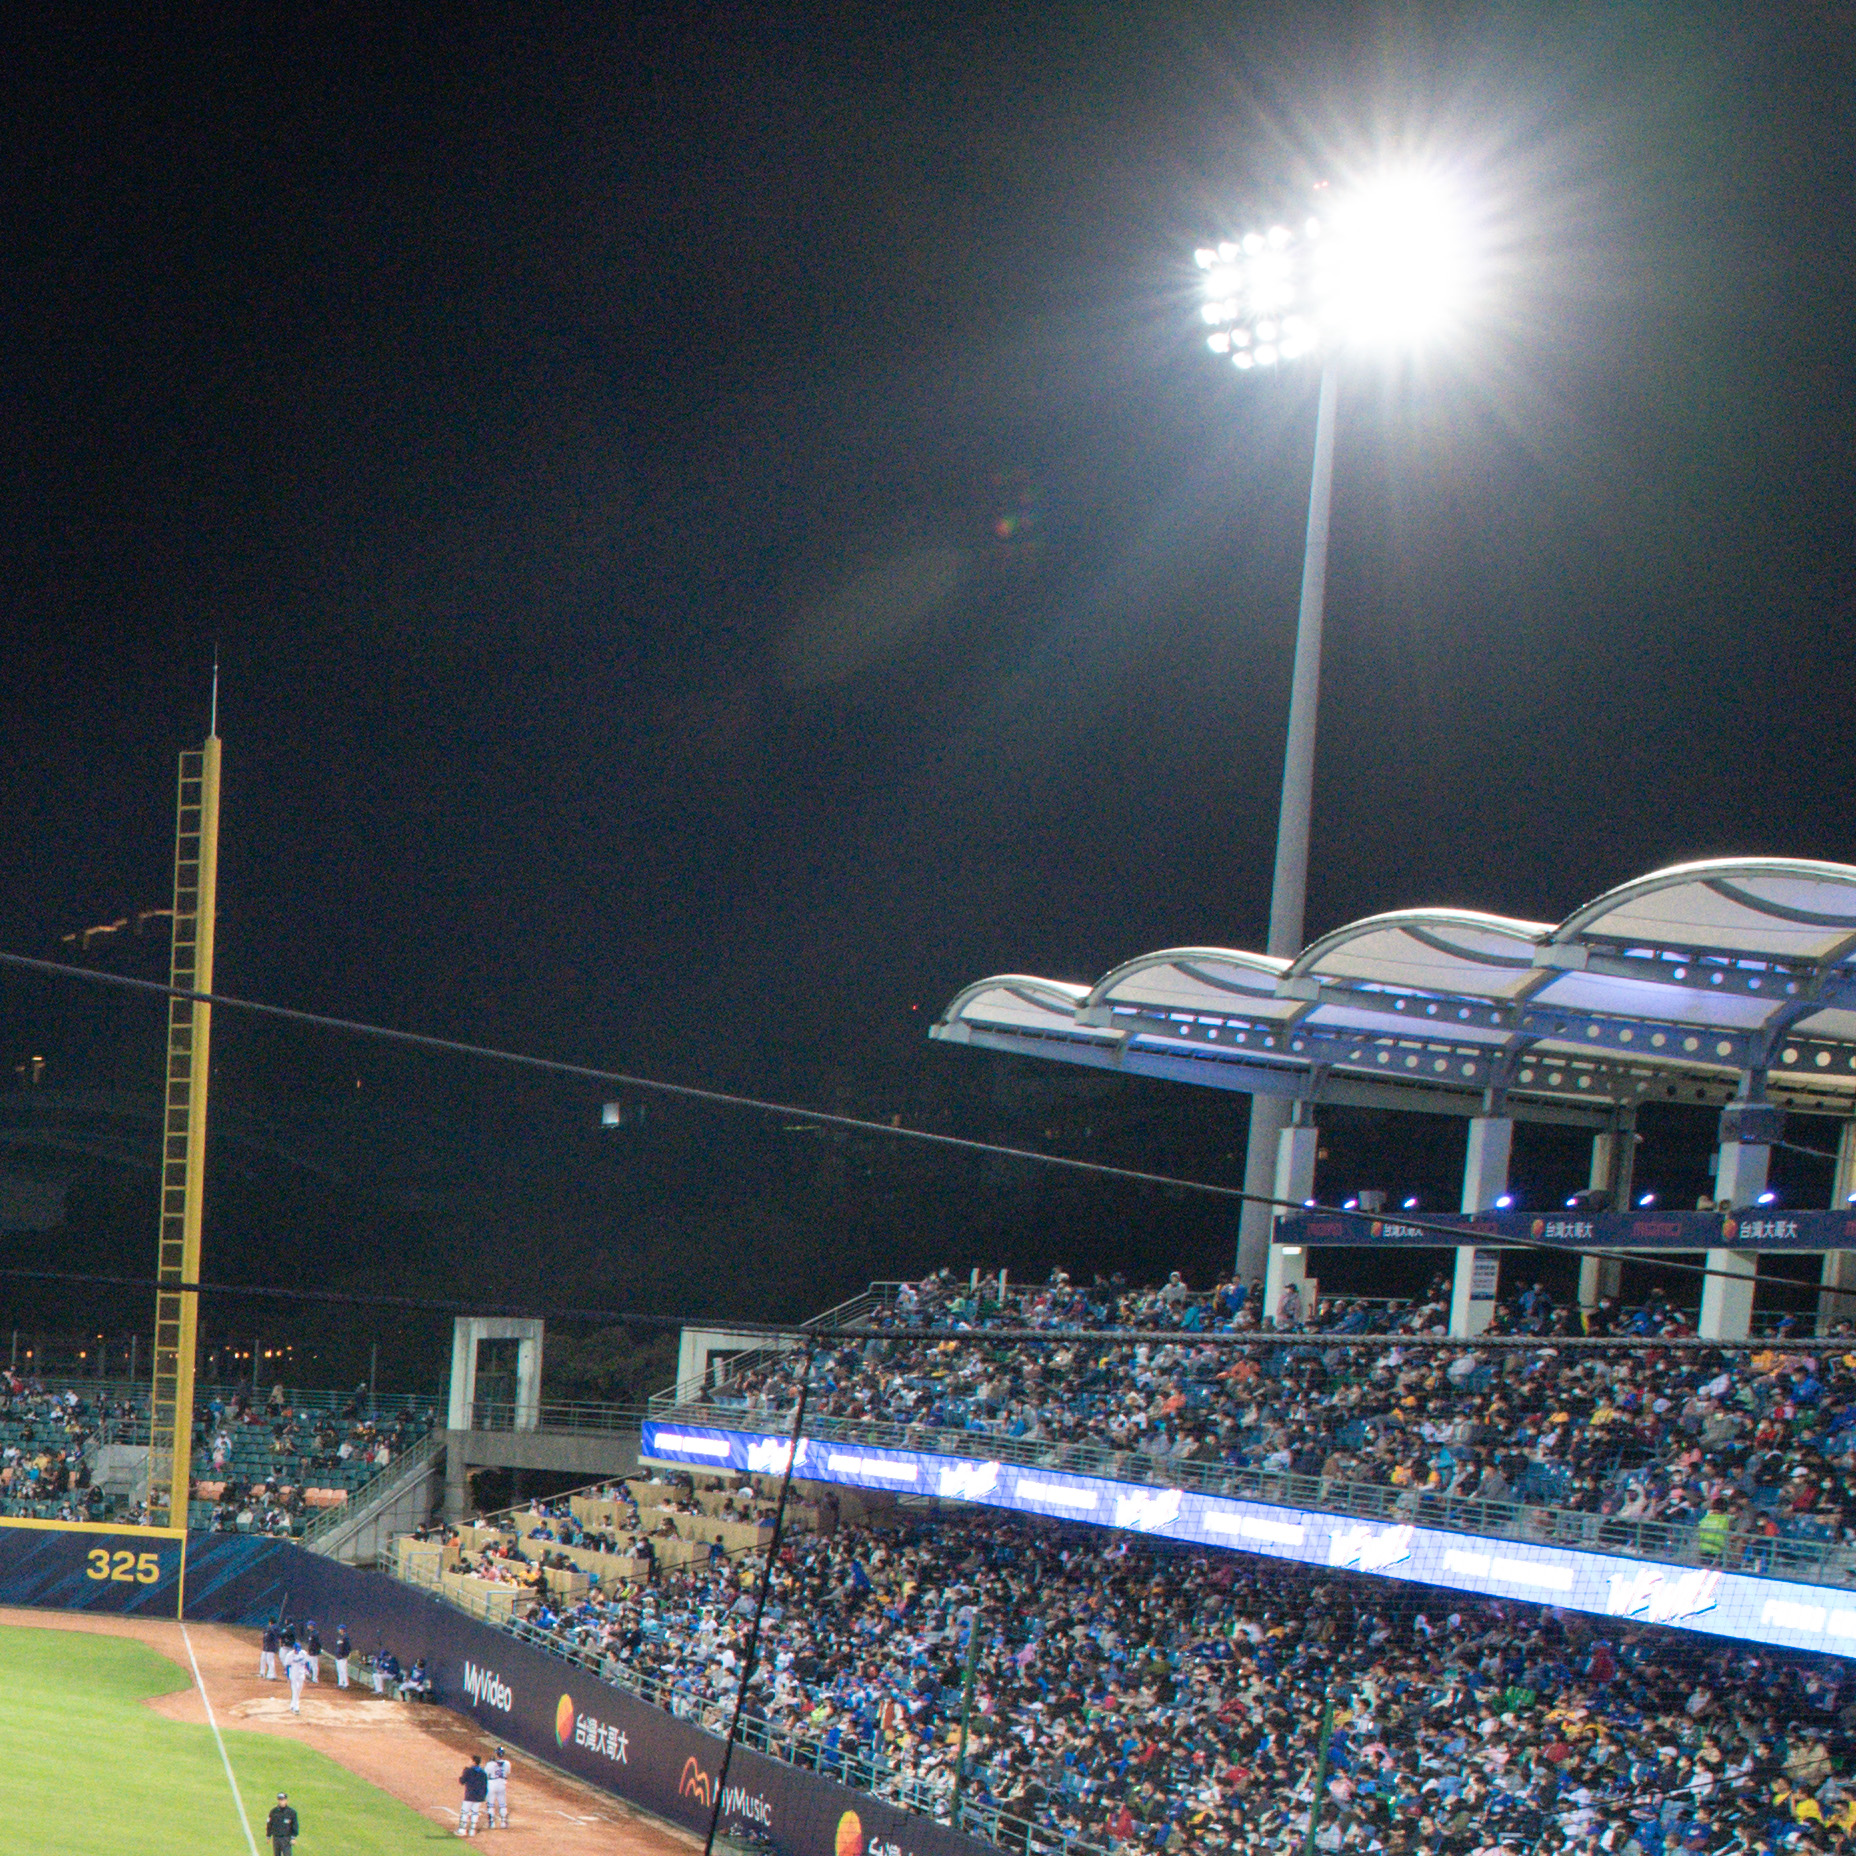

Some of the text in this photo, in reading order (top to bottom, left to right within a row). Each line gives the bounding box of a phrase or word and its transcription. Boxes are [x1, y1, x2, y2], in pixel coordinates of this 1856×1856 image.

[1740, 1221, 1798, 1239] 台灣大哥大
[87, 1548, 160, 1585] 325
[463, 1661, 513, 1713] MyVideo
[574, 1712, 628, 1764] 台灣大哥大
